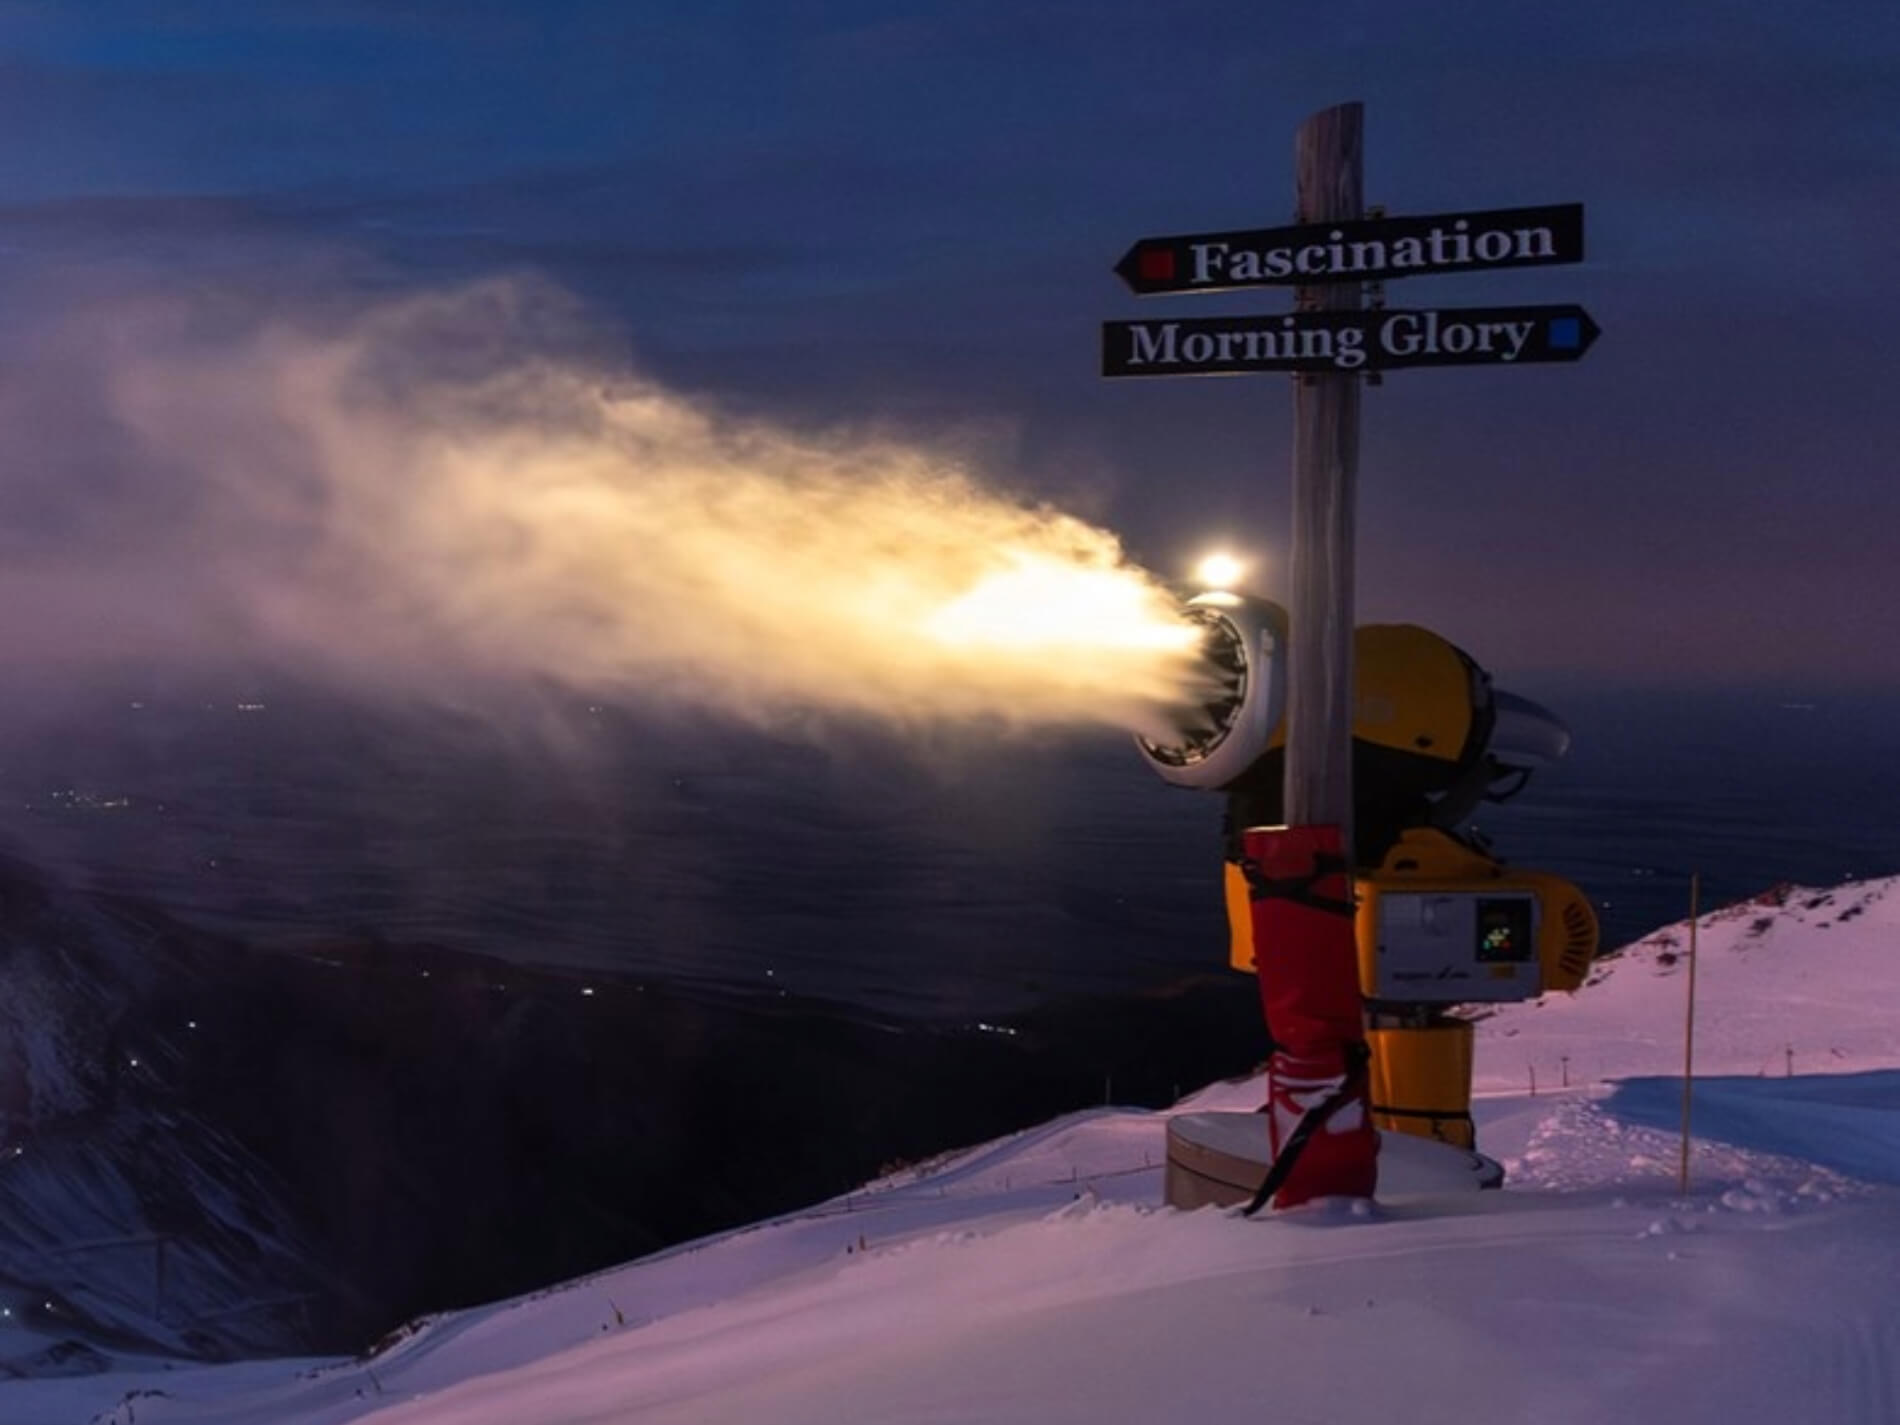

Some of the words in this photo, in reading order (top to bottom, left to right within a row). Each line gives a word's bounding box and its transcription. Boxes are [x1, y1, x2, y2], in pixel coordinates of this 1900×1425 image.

[1190, 221, 1556, 282] Fascination
[1127, 318, 1365, 367] Morning
[1381, 312, 1534, 360] Glory
